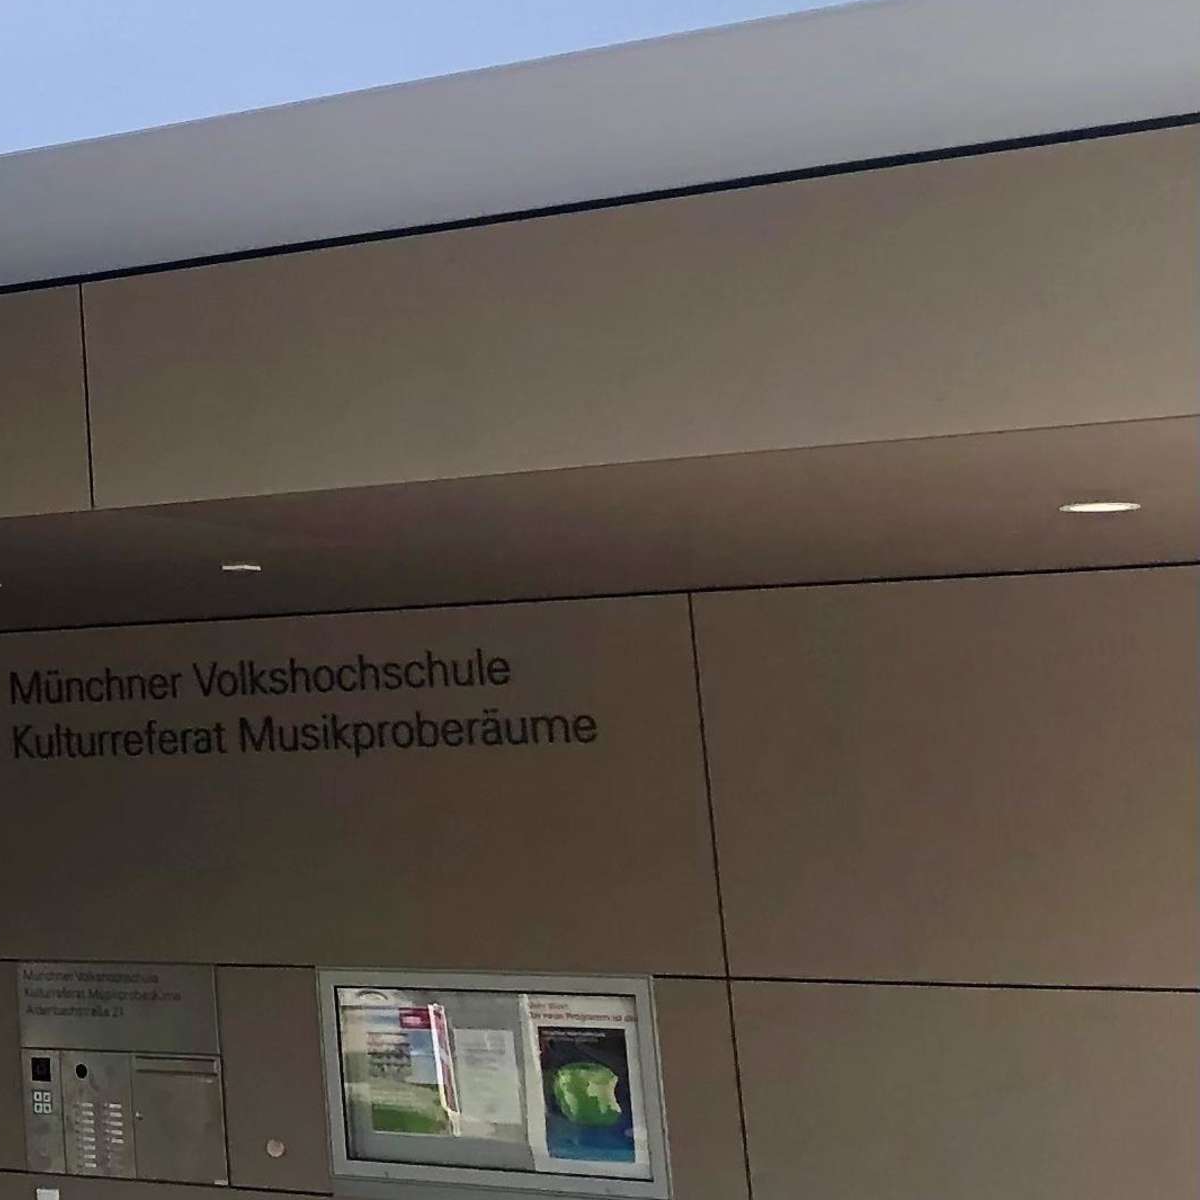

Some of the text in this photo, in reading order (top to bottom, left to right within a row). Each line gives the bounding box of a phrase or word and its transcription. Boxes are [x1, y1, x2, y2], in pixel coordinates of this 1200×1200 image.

[10, 648, 512, 705] Münchner Volkshochschule
[13, 709, 598, 759] Kulturreferat Musikproberäume
